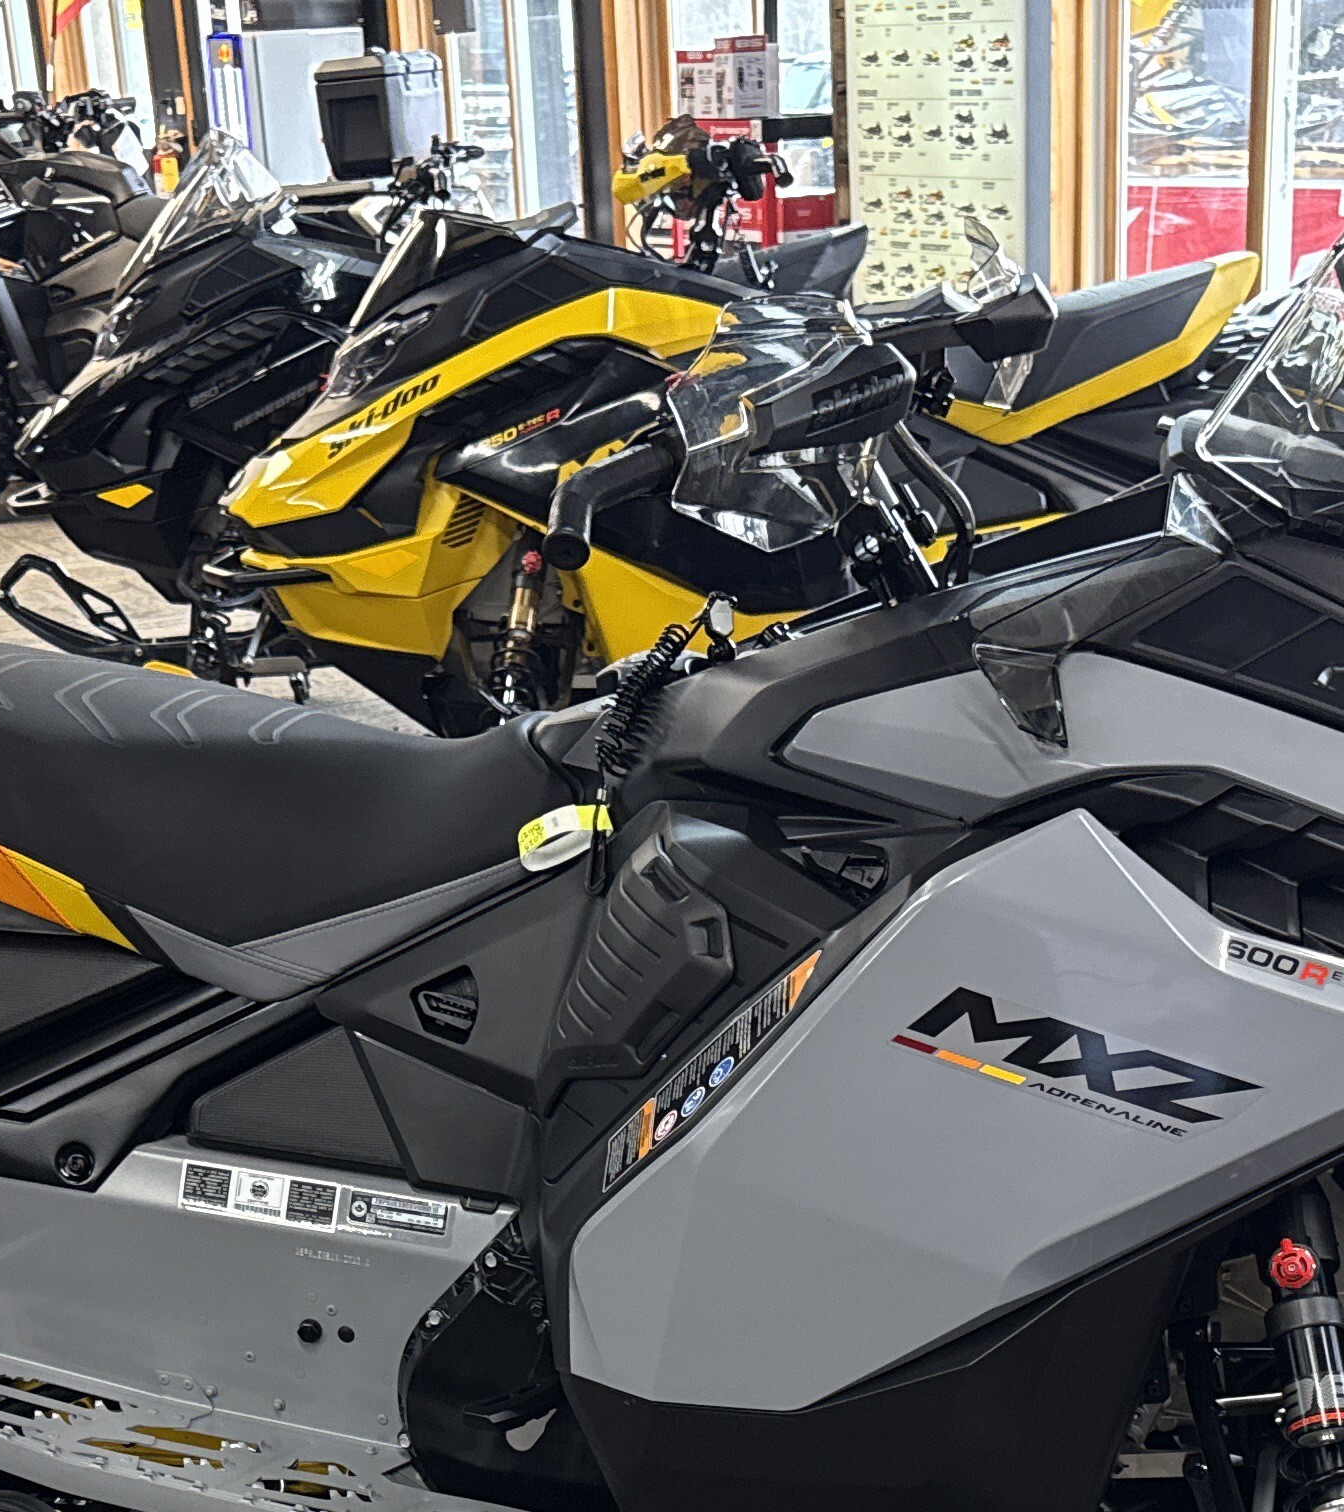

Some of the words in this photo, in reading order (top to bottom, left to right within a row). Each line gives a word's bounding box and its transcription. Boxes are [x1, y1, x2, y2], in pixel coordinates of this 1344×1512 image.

[327, 373, 441, 460] ski-doo
[906, 986, 1265, 1124] MXZ
[1027, 1082, 1188, 1138] ADRENALINE
